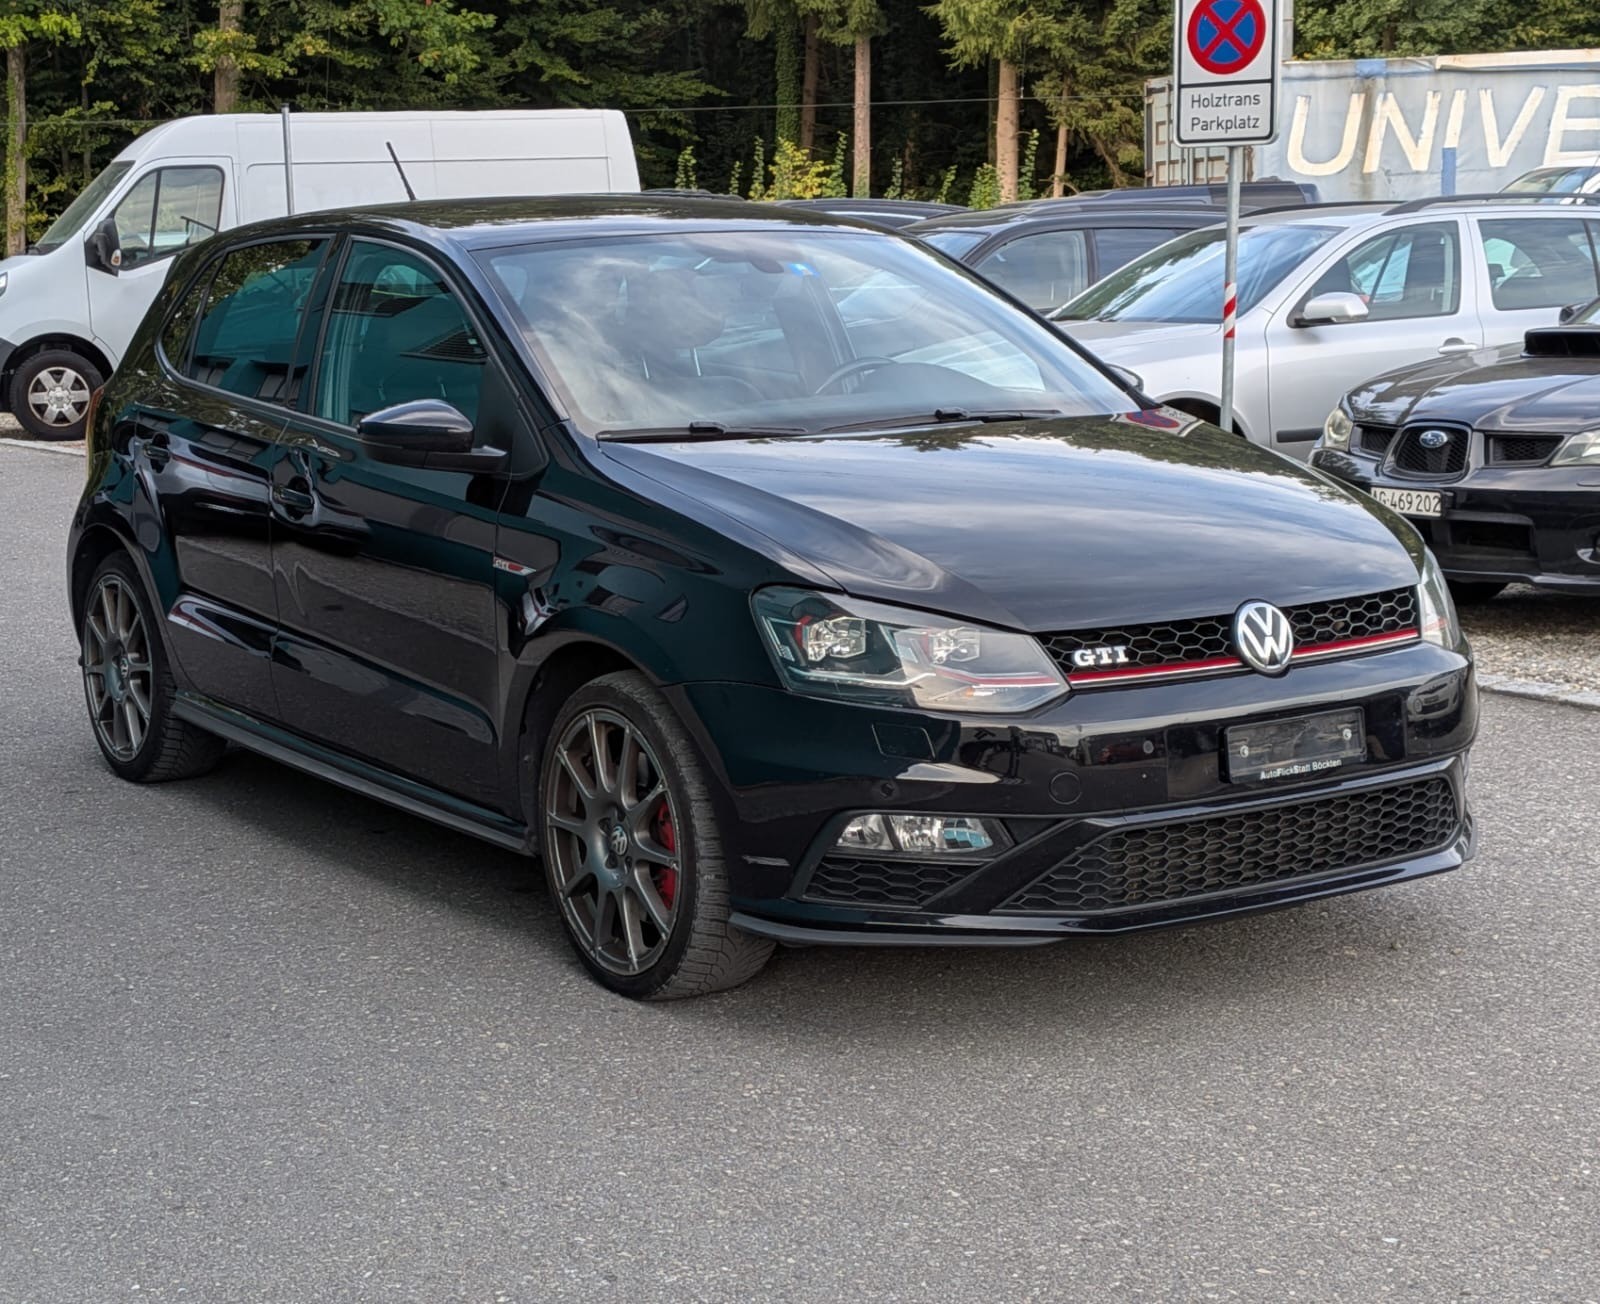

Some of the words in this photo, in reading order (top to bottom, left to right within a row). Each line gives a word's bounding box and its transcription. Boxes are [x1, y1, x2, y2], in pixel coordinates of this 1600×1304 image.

[1191, 92, 1261, 109] Holztrans
[1191, 114, 1260, 134] Parkplatz
[1287, 84, 1600, 176] UNIVE
[1237, 602, 1294, 672] VW
[1074, 645, 1129, 667] GTI
